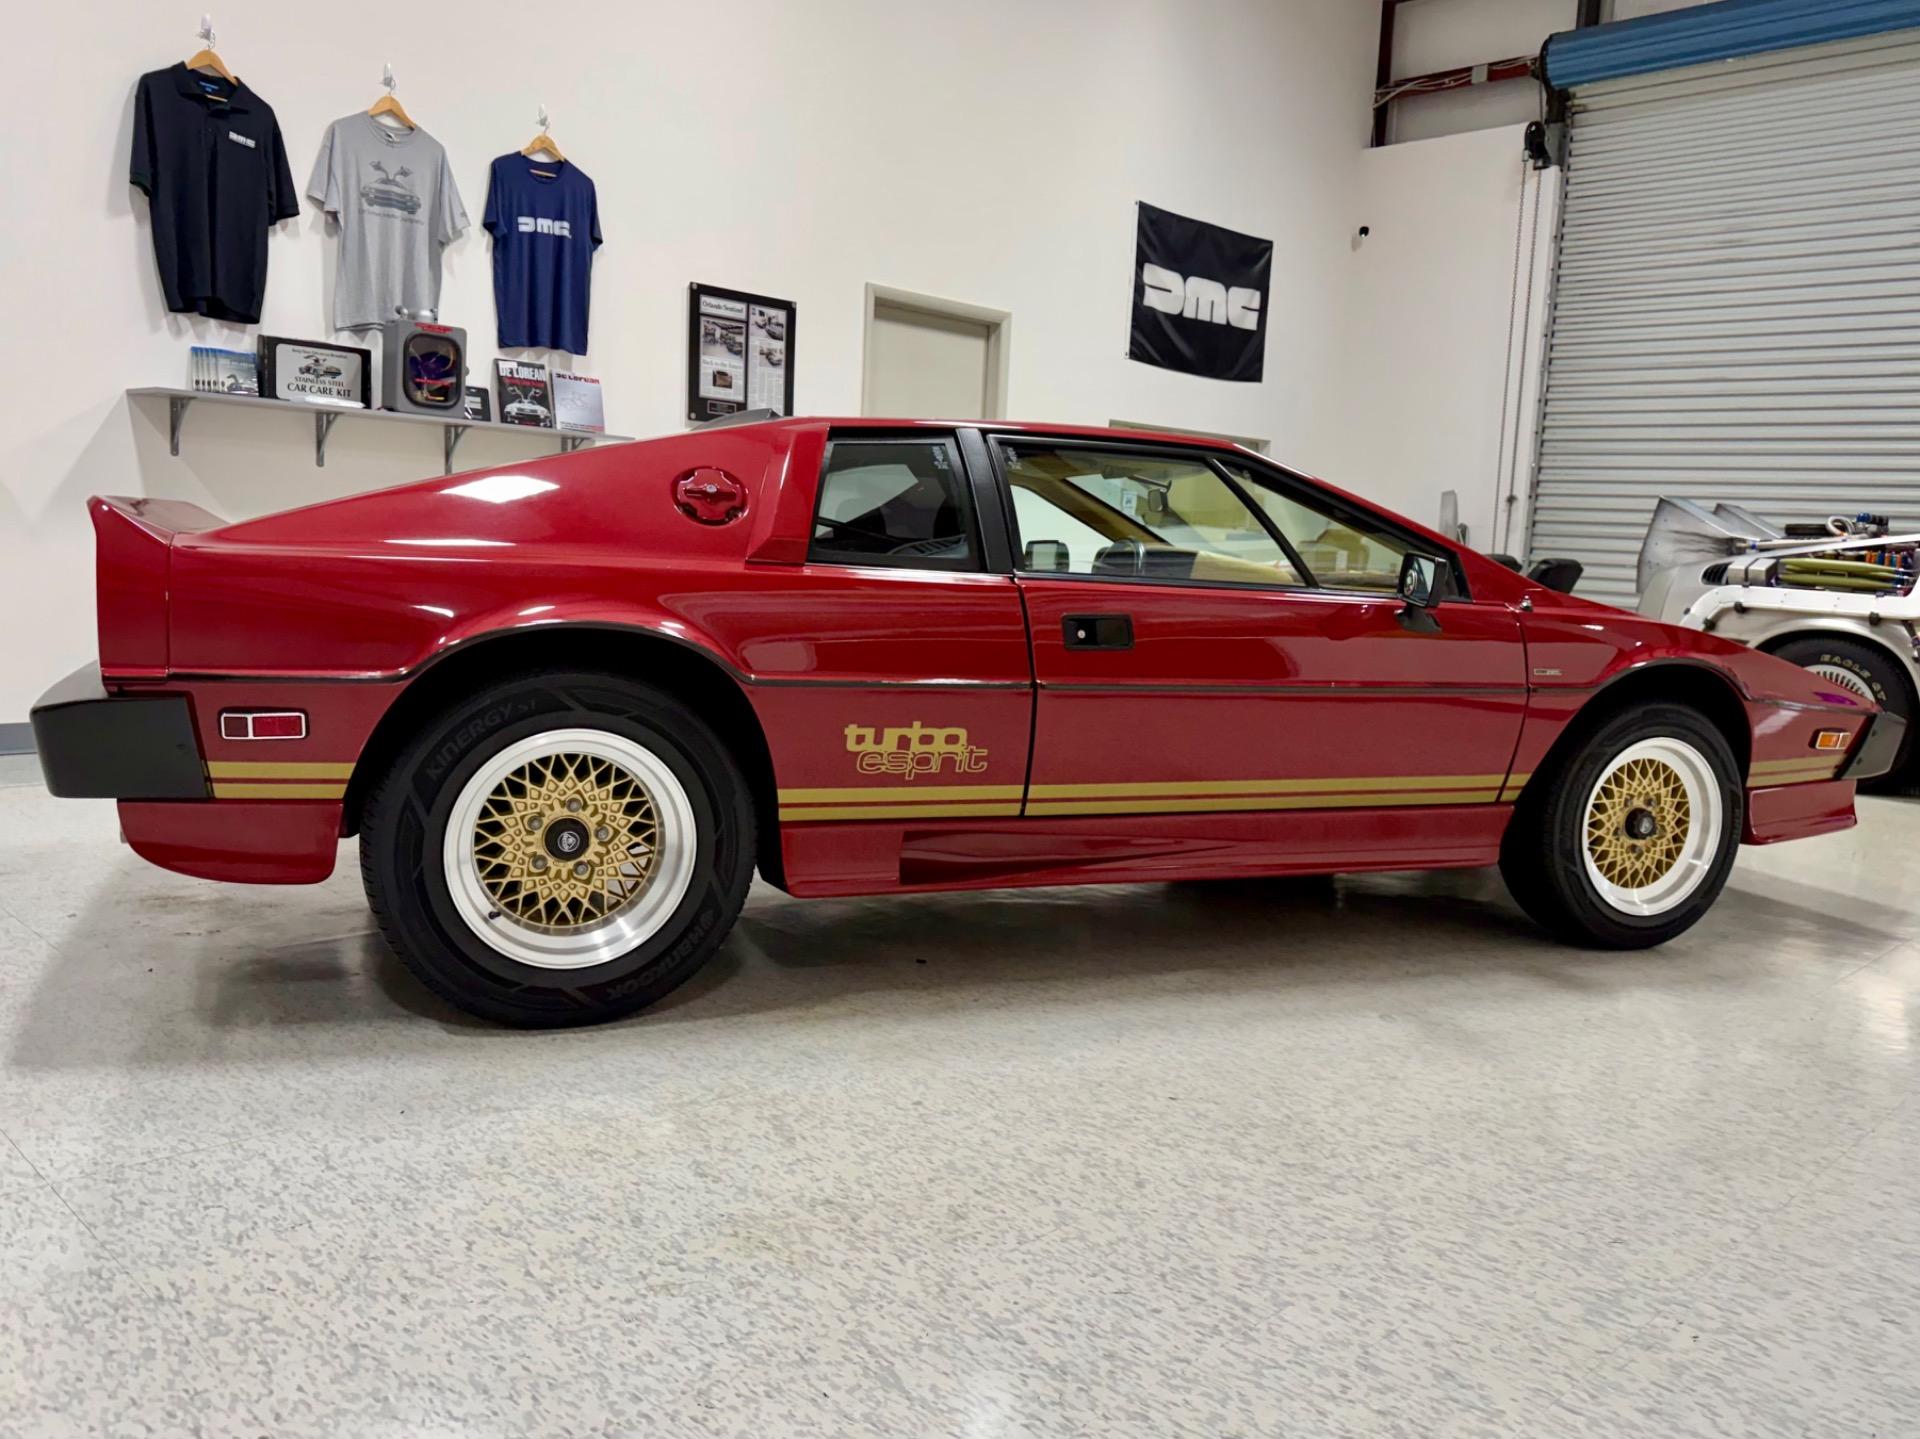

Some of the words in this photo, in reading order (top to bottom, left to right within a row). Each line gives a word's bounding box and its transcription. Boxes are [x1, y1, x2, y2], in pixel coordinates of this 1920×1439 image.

[1143, 262, 1261, 331] DMC
[287, 382, 307, 393] CAR
[309, 384, 334, 396] CARE
[336, 388, 353, 398] KIT
[294, 376, 327, 385] STAINLESS
[328, 380, 344, 388] STEEL
[844, 720, 968, 752] turbo
[856, 745, 988, 781] esprit
